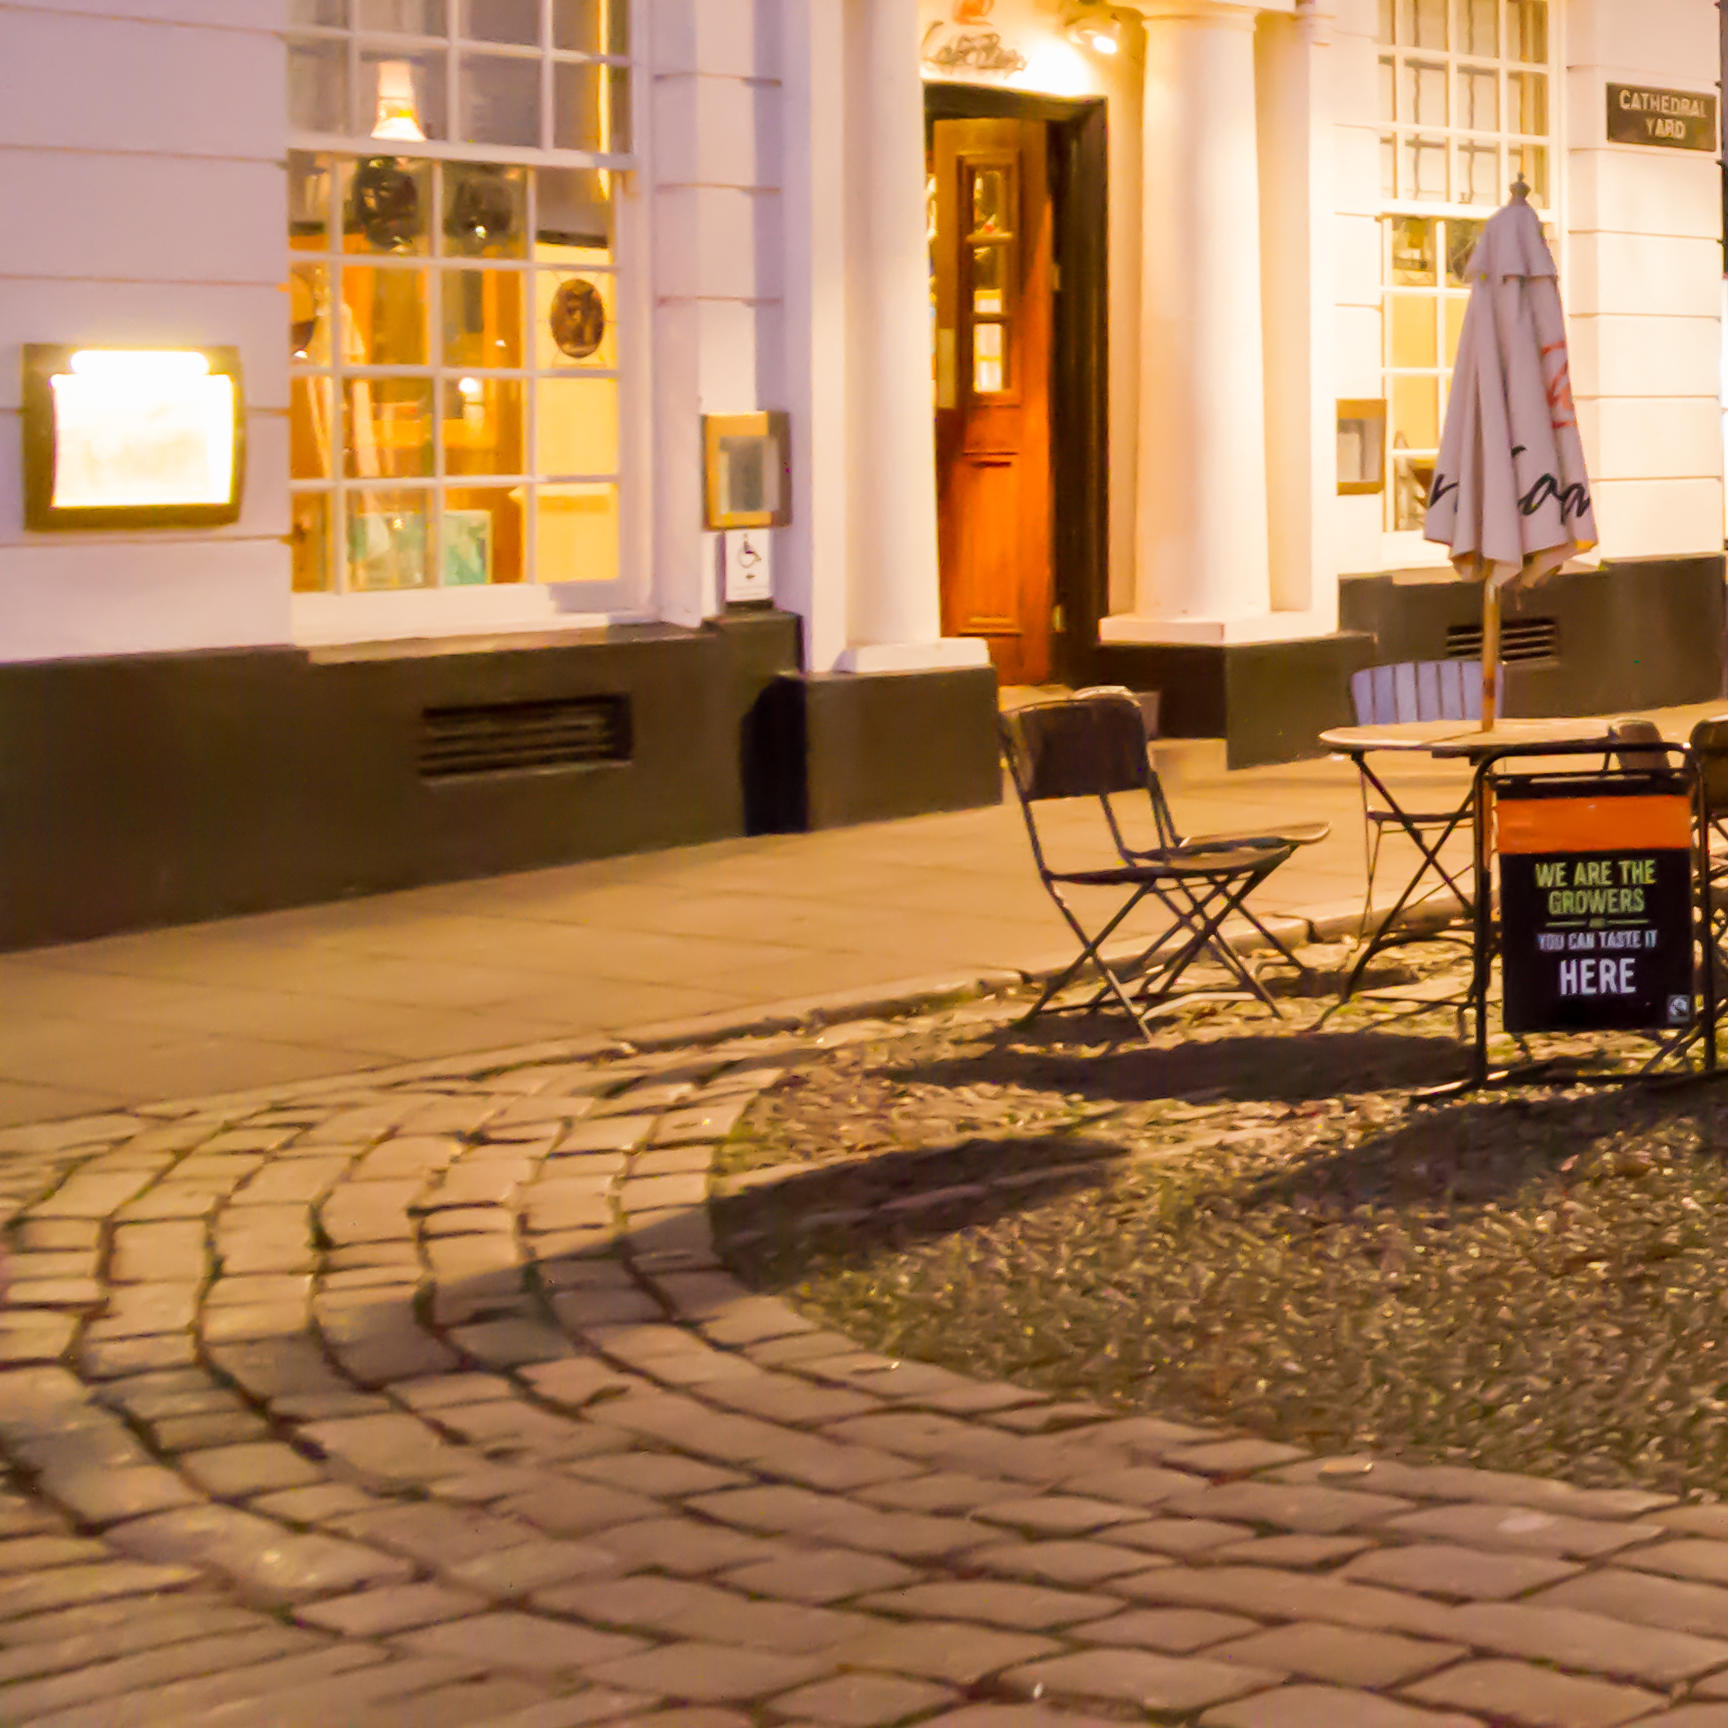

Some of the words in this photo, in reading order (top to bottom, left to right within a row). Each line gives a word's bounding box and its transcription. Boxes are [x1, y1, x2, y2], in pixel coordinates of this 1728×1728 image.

[1619, 89, 1707, 118] CATHEDRAL
[1645, 117, 1686, 140] YARD
[1535, 862, 1567, 888] WE
[1573, 860, 1613, 887] ARE
[1618, 859, 1657, 885] THE
[1548, 888, 1645, 915] GROWERS
[1537, 932, 1565, 951] YOU
[1568, 931, 1595, 950] CAN
[1599, 930, 1641, 949] TASTE
[1644, 929, 1658, 949] IT
[1559, 958, 1637, 997] HERE
